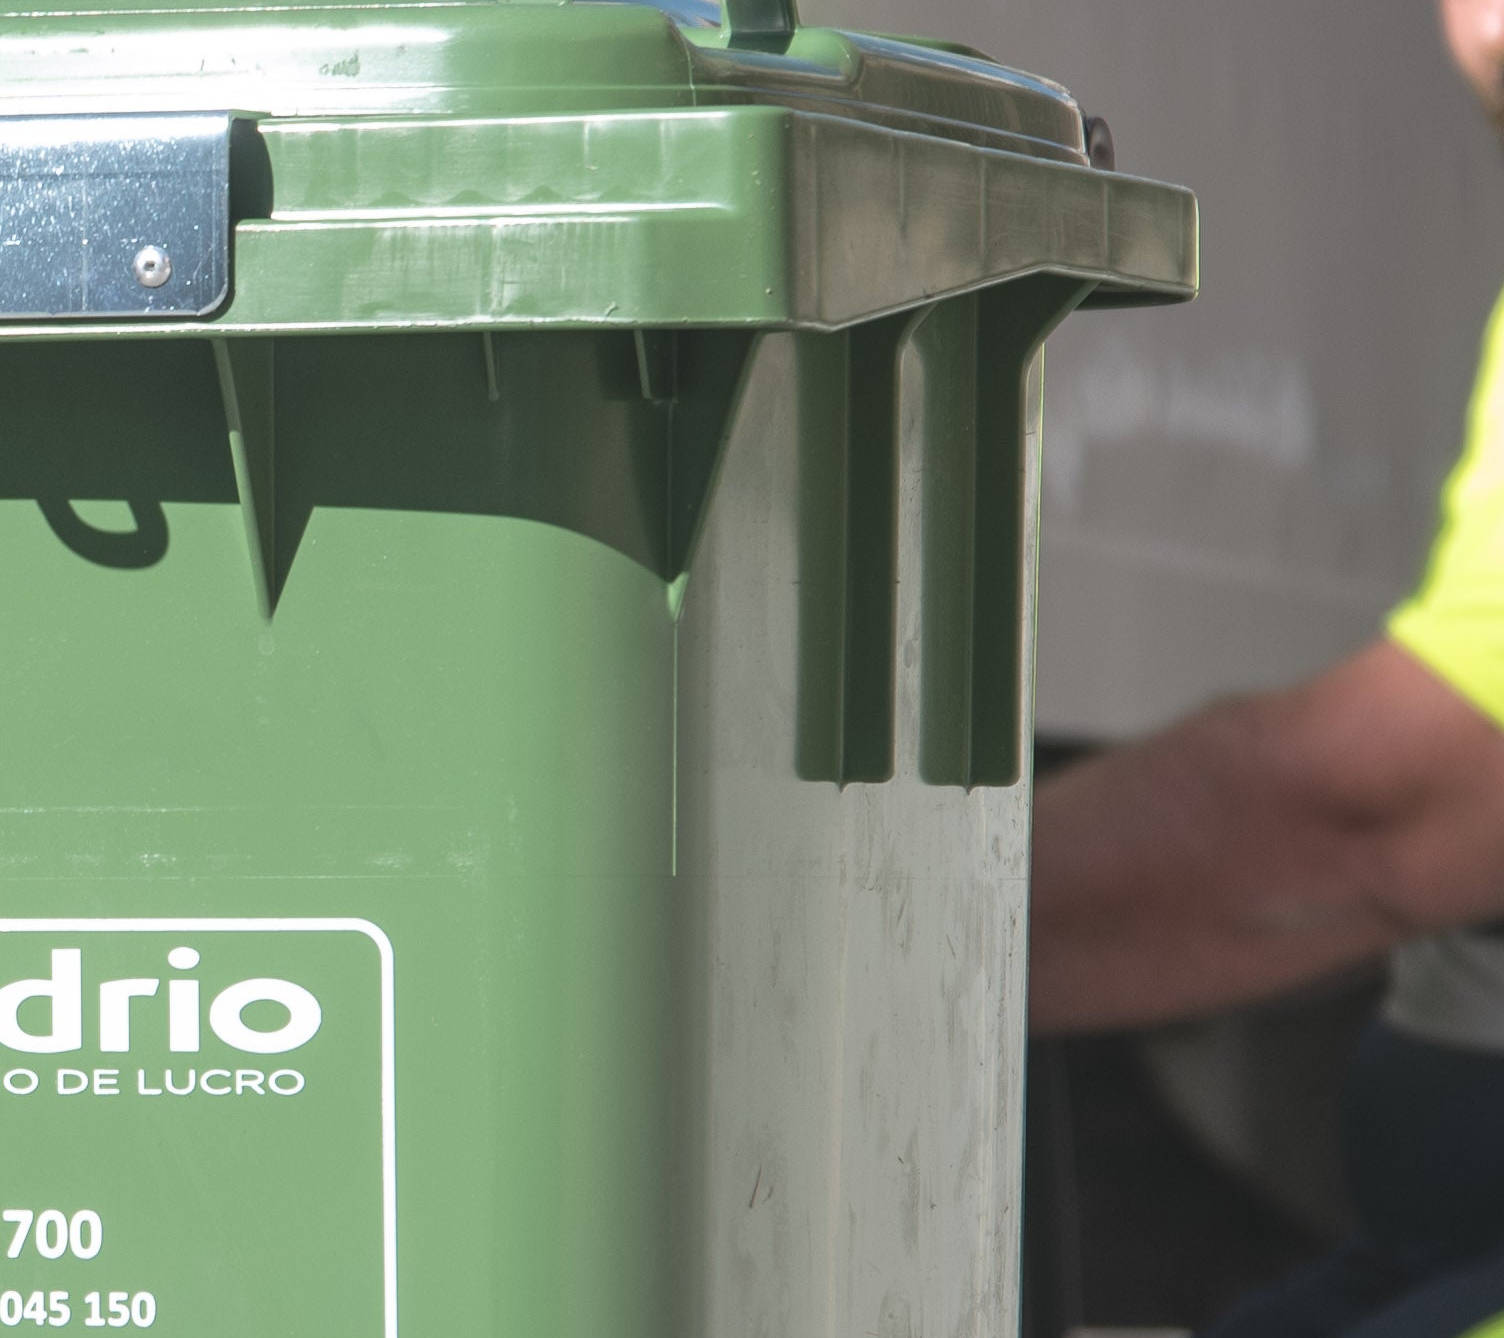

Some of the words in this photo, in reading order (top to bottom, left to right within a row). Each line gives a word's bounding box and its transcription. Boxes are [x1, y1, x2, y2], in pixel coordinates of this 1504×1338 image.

[57, 1068, 120, 1095] DE
[137, 1068, 305, 1096] LUCRO
[2, 1209, 103, 1259] 700
[0, 1290, 72, 1327] 045
[84, 1291, 157, 1328] 150
